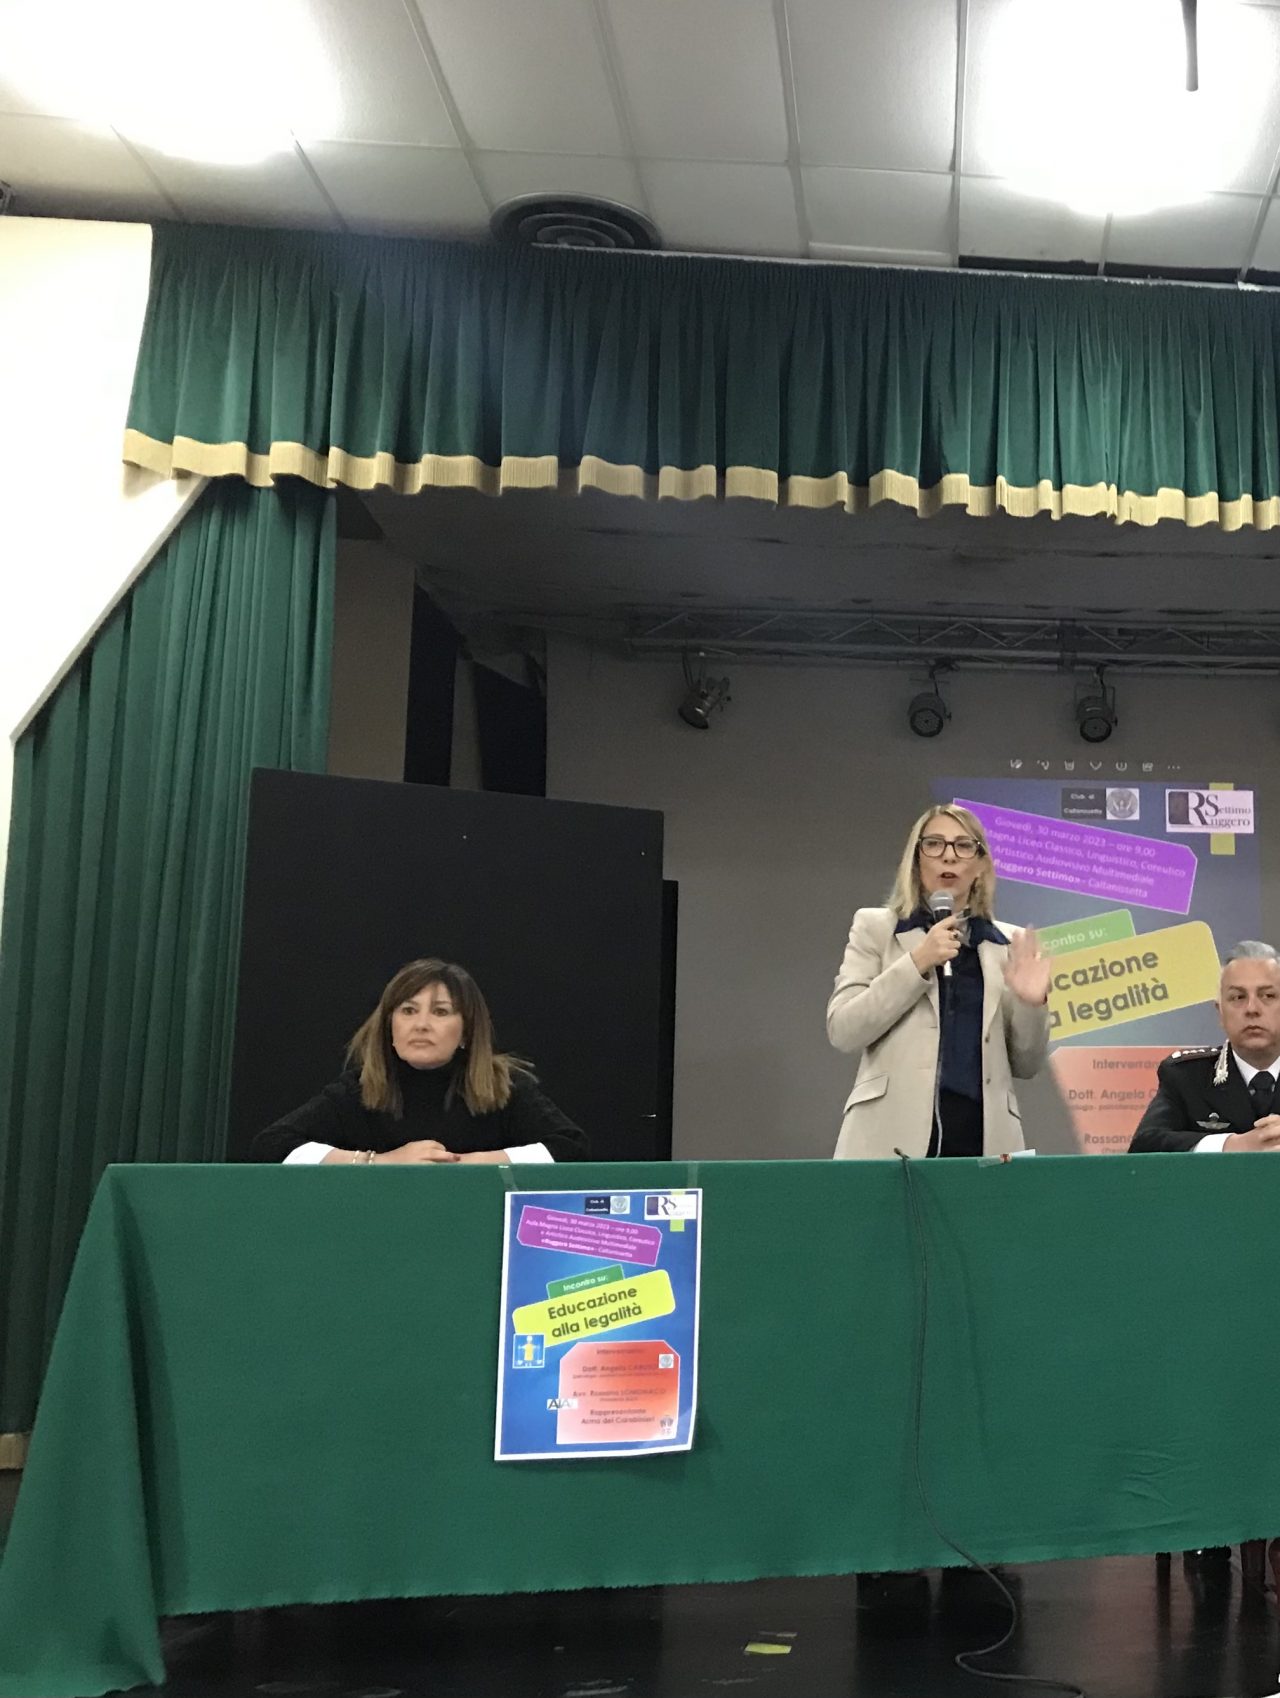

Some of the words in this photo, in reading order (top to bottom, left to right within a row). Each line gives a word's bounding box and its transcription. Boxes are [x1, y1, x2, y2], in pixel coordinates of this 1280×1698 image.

[1019, 836, 1043, 848] Liceo
[1038, 825, 1048, 834] 30
[1051, 830, 1080, 842] marzo
[1116, 844, 1132, 852] ore
[993, 858, 1034, 875] Ruggero
[994, 846, 1033, 860] Artistico
[1036, 854, 1090, 872] Audiovisivo
[1092, 864, 1154, 886] Multimediale
[1042, 930, 1086, 950] contro
[1088, 927, 1106, 940] su:
[1049, 952, 1158, 994] cazione
[1068, 977, 1169, 1022] legalità
[1101, 1088, 1144, 1101] Angela
[1084, 1133, 1133, 1144] Rossan
[563, 1279, 595, 1291] Incontro
[548, 1288, 638, 1319] Educazione
[552, 1321, 580, 1338] alla
[584, 1302, 642, 1328] legalità
